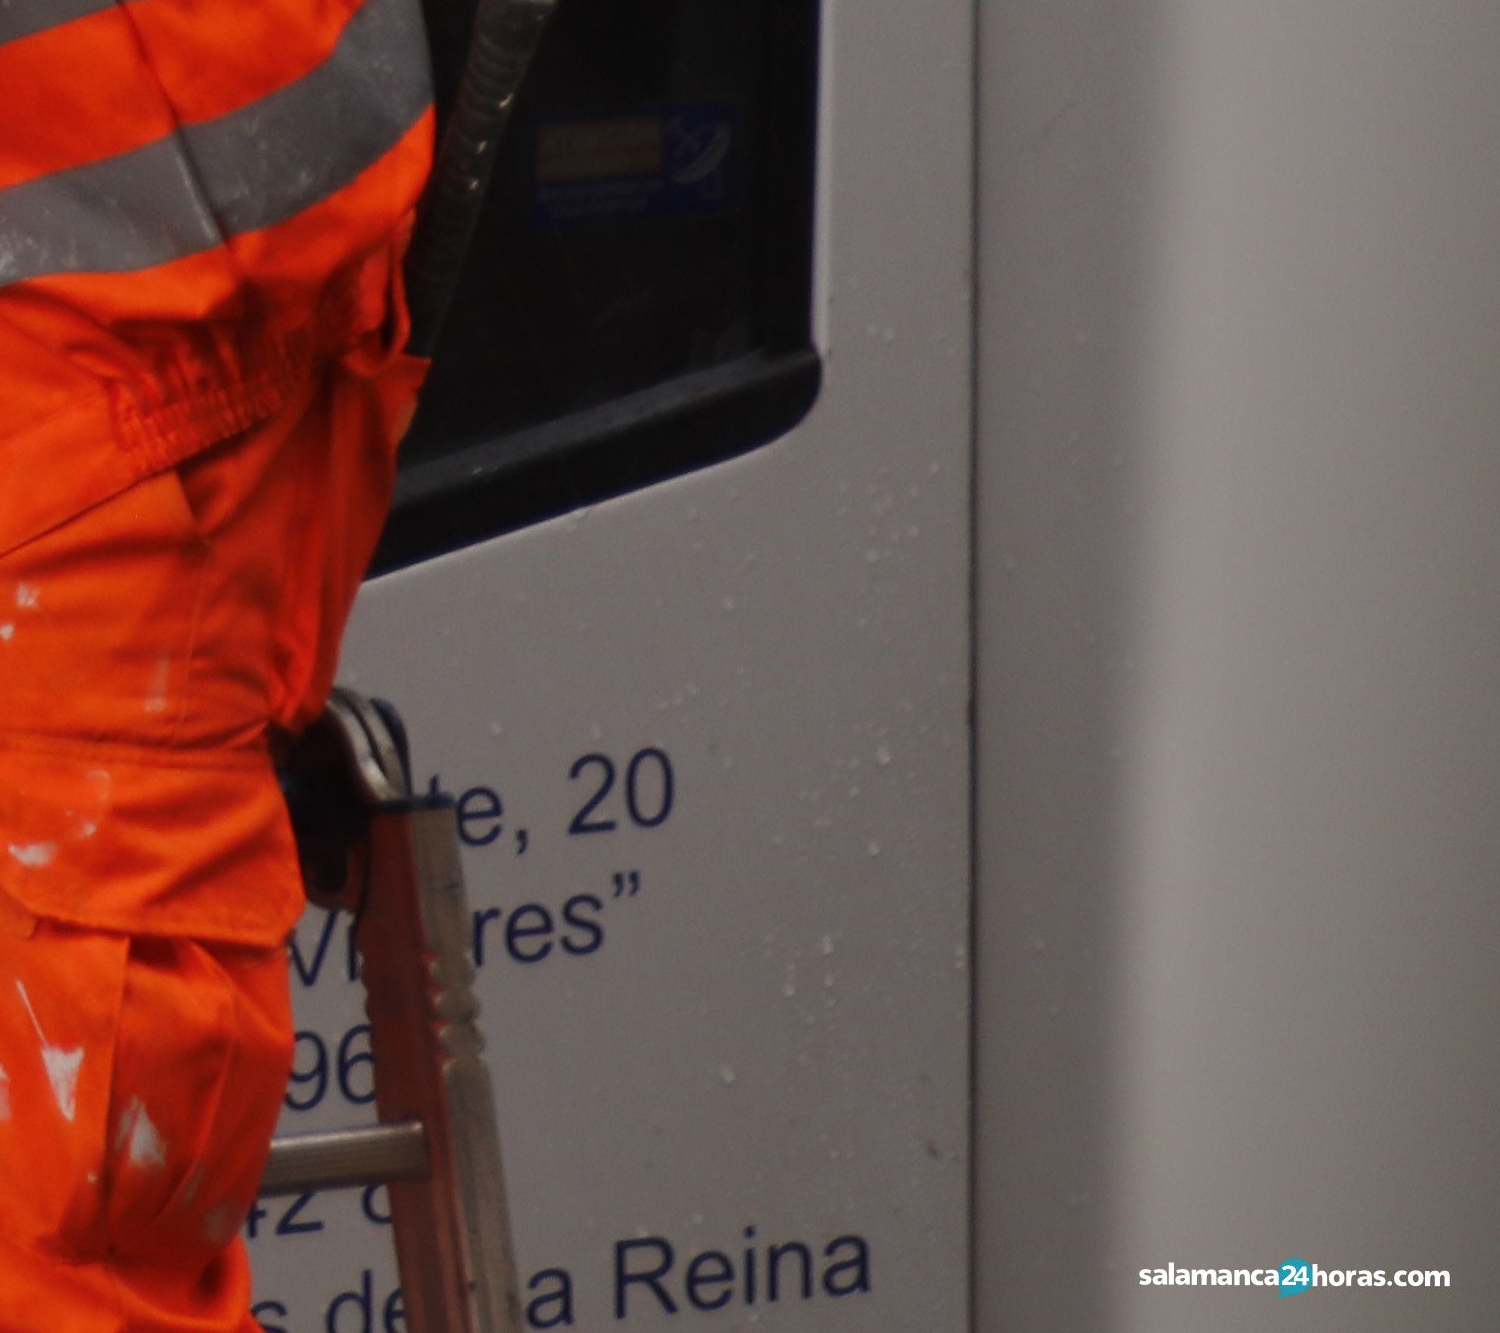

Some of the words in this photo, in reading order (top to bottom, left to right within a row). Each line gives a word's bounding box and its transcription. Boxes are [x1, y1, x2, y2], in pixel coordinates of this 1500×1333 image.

[568, 747, 675, 836] 20
[526, 1266, 576, 1329] a
[612, 1224, 875, 1320] Reina
